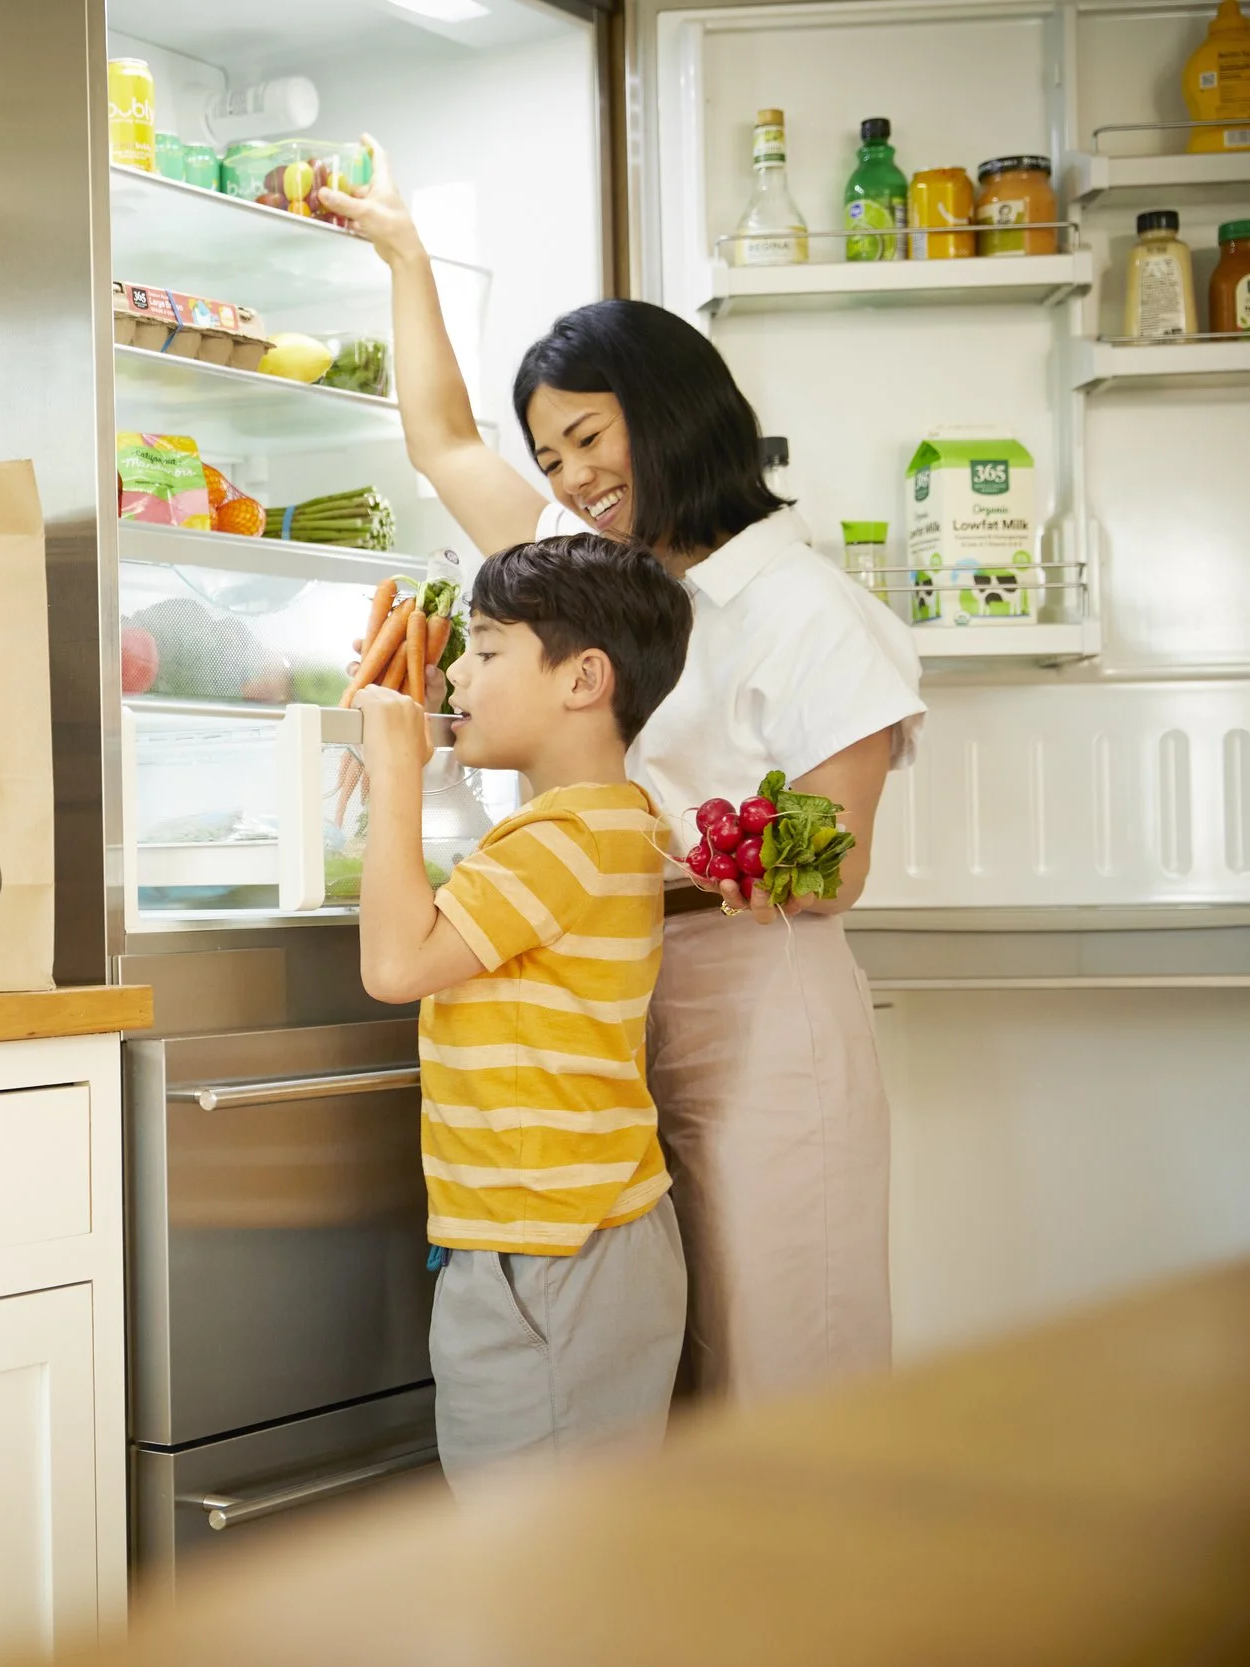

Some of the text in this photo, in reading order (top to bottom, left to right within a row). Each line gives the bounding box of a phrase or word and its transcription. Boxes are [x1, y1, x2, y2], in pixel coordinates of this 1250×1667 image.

[133, 290, 147, 303] 365
[973, 464, 1006, 483] 365
[972, 504, 1008, 515] Organic
[953, 519, 1028, 531] Lowfat Milk
